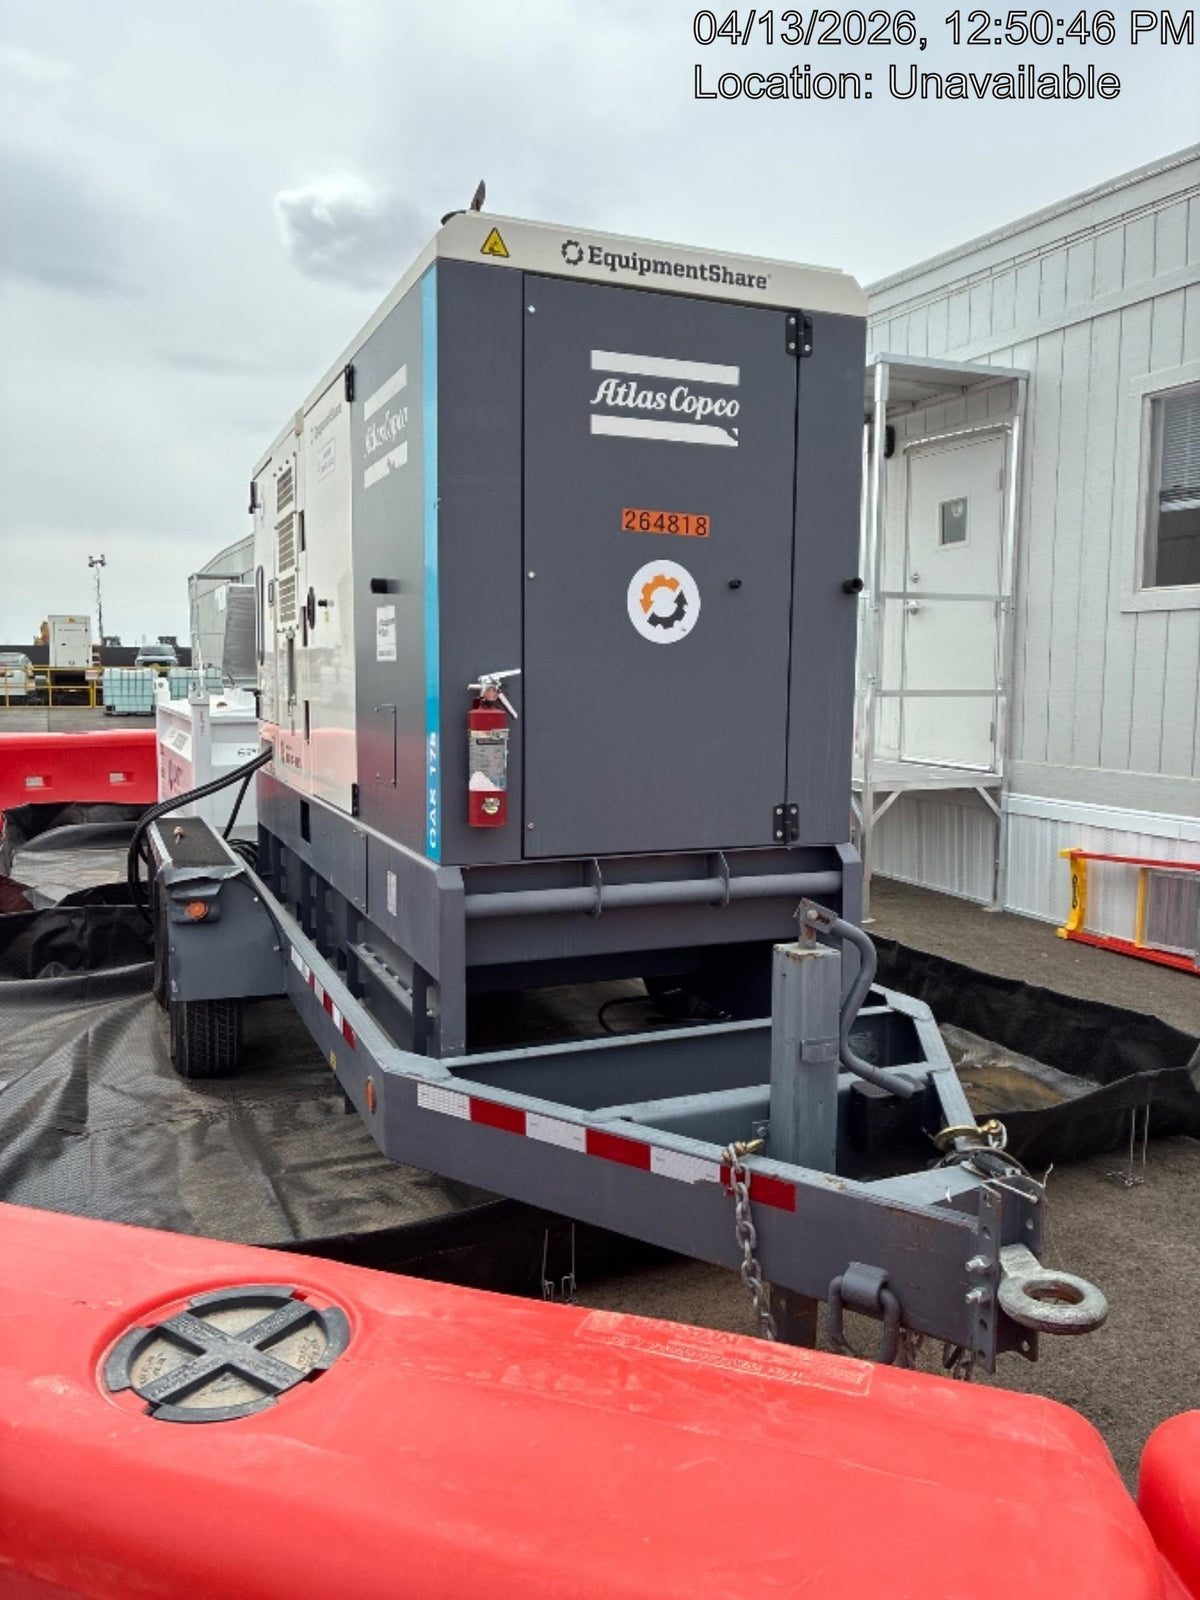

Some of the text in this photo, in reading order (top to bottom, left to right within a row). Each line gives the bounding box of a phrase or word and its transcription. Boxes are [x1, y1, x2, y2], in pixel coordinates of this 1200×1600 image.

[588, 245, 768, 289] EquipmentShare
[590, 378, 741, 420] Atlas Copco
[624, 510, 707, 536] 264818
